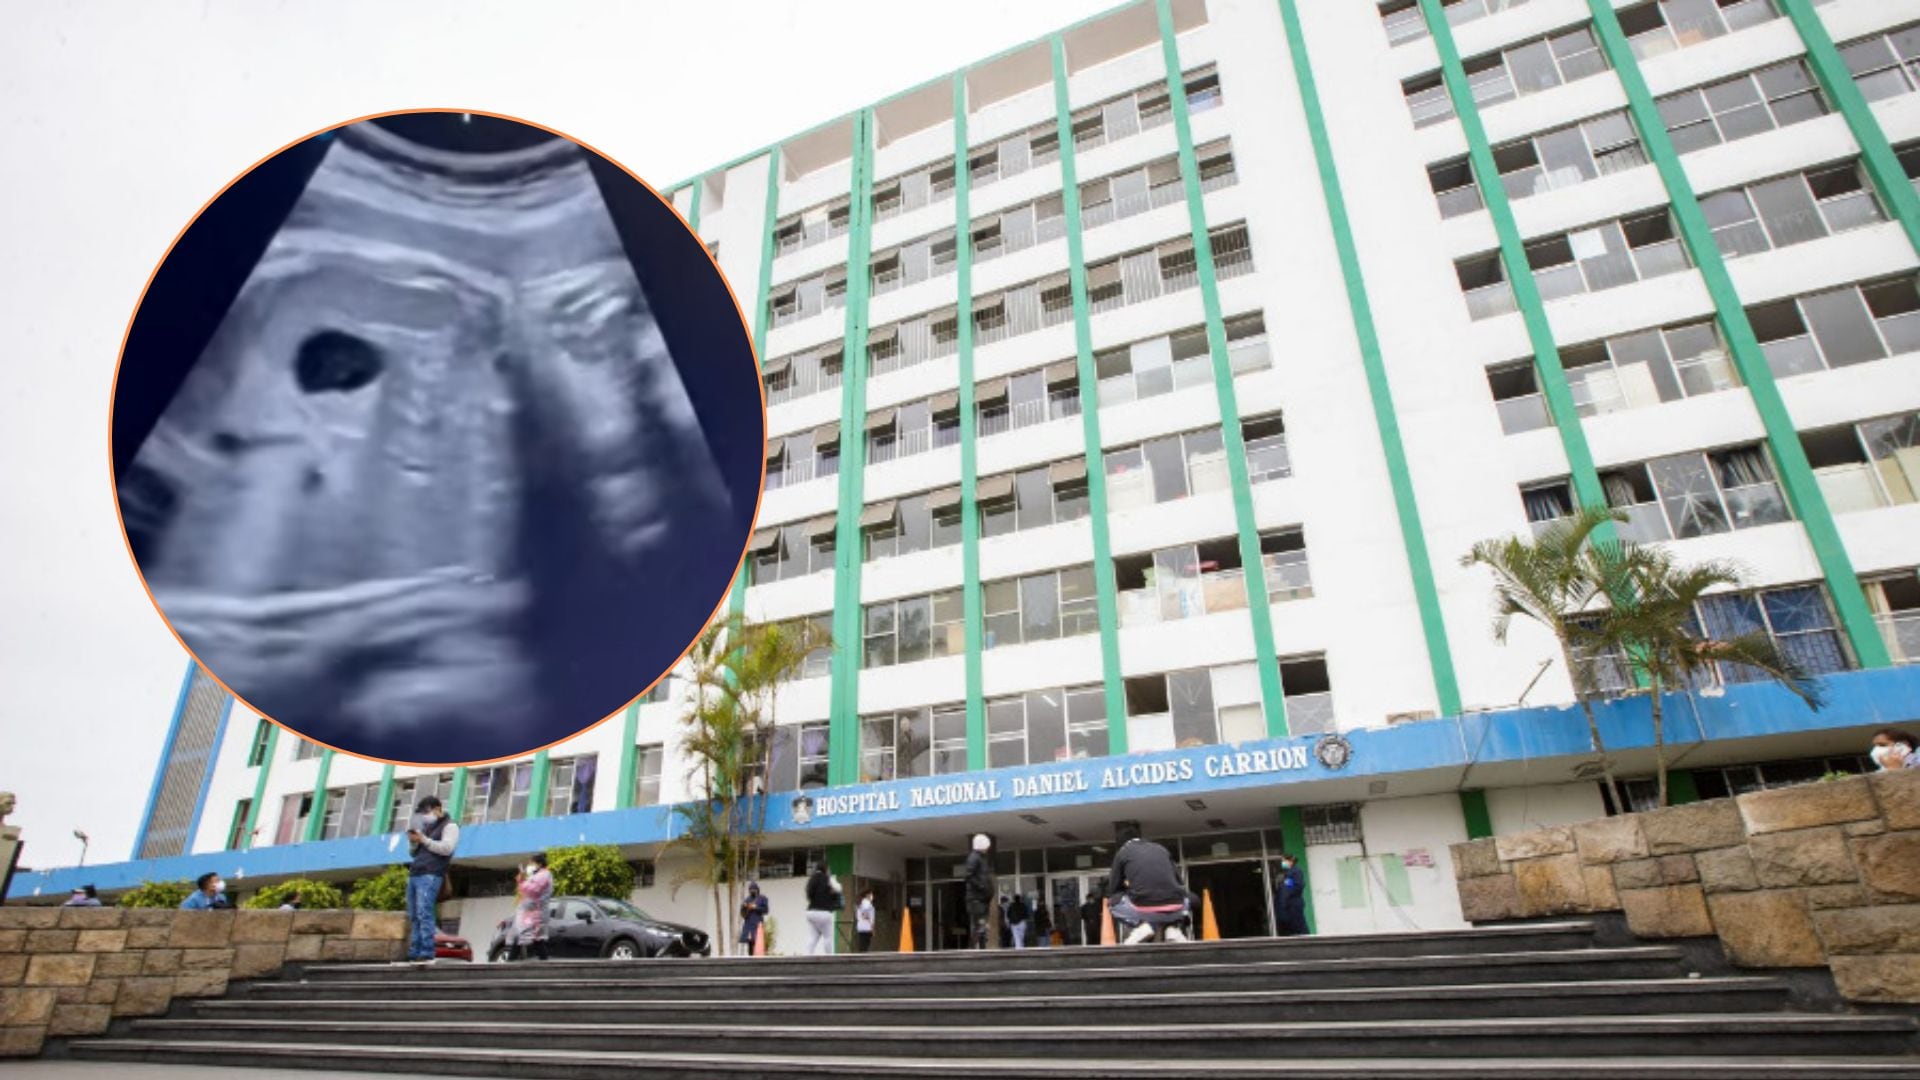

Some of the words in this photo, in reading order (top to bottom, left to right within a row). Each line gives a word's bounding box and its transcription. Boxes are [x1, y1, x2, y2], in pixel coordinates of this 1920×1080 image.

[817, 791, 898, 815] HOSPITAL
[910, 780, 1000, 807] NACIONAL
[1013, 770, 1088, 797] DANIEL
[1102, 759, 1192, 788] ALCIDES
[1205, 746, 1309, 777] CARRION
